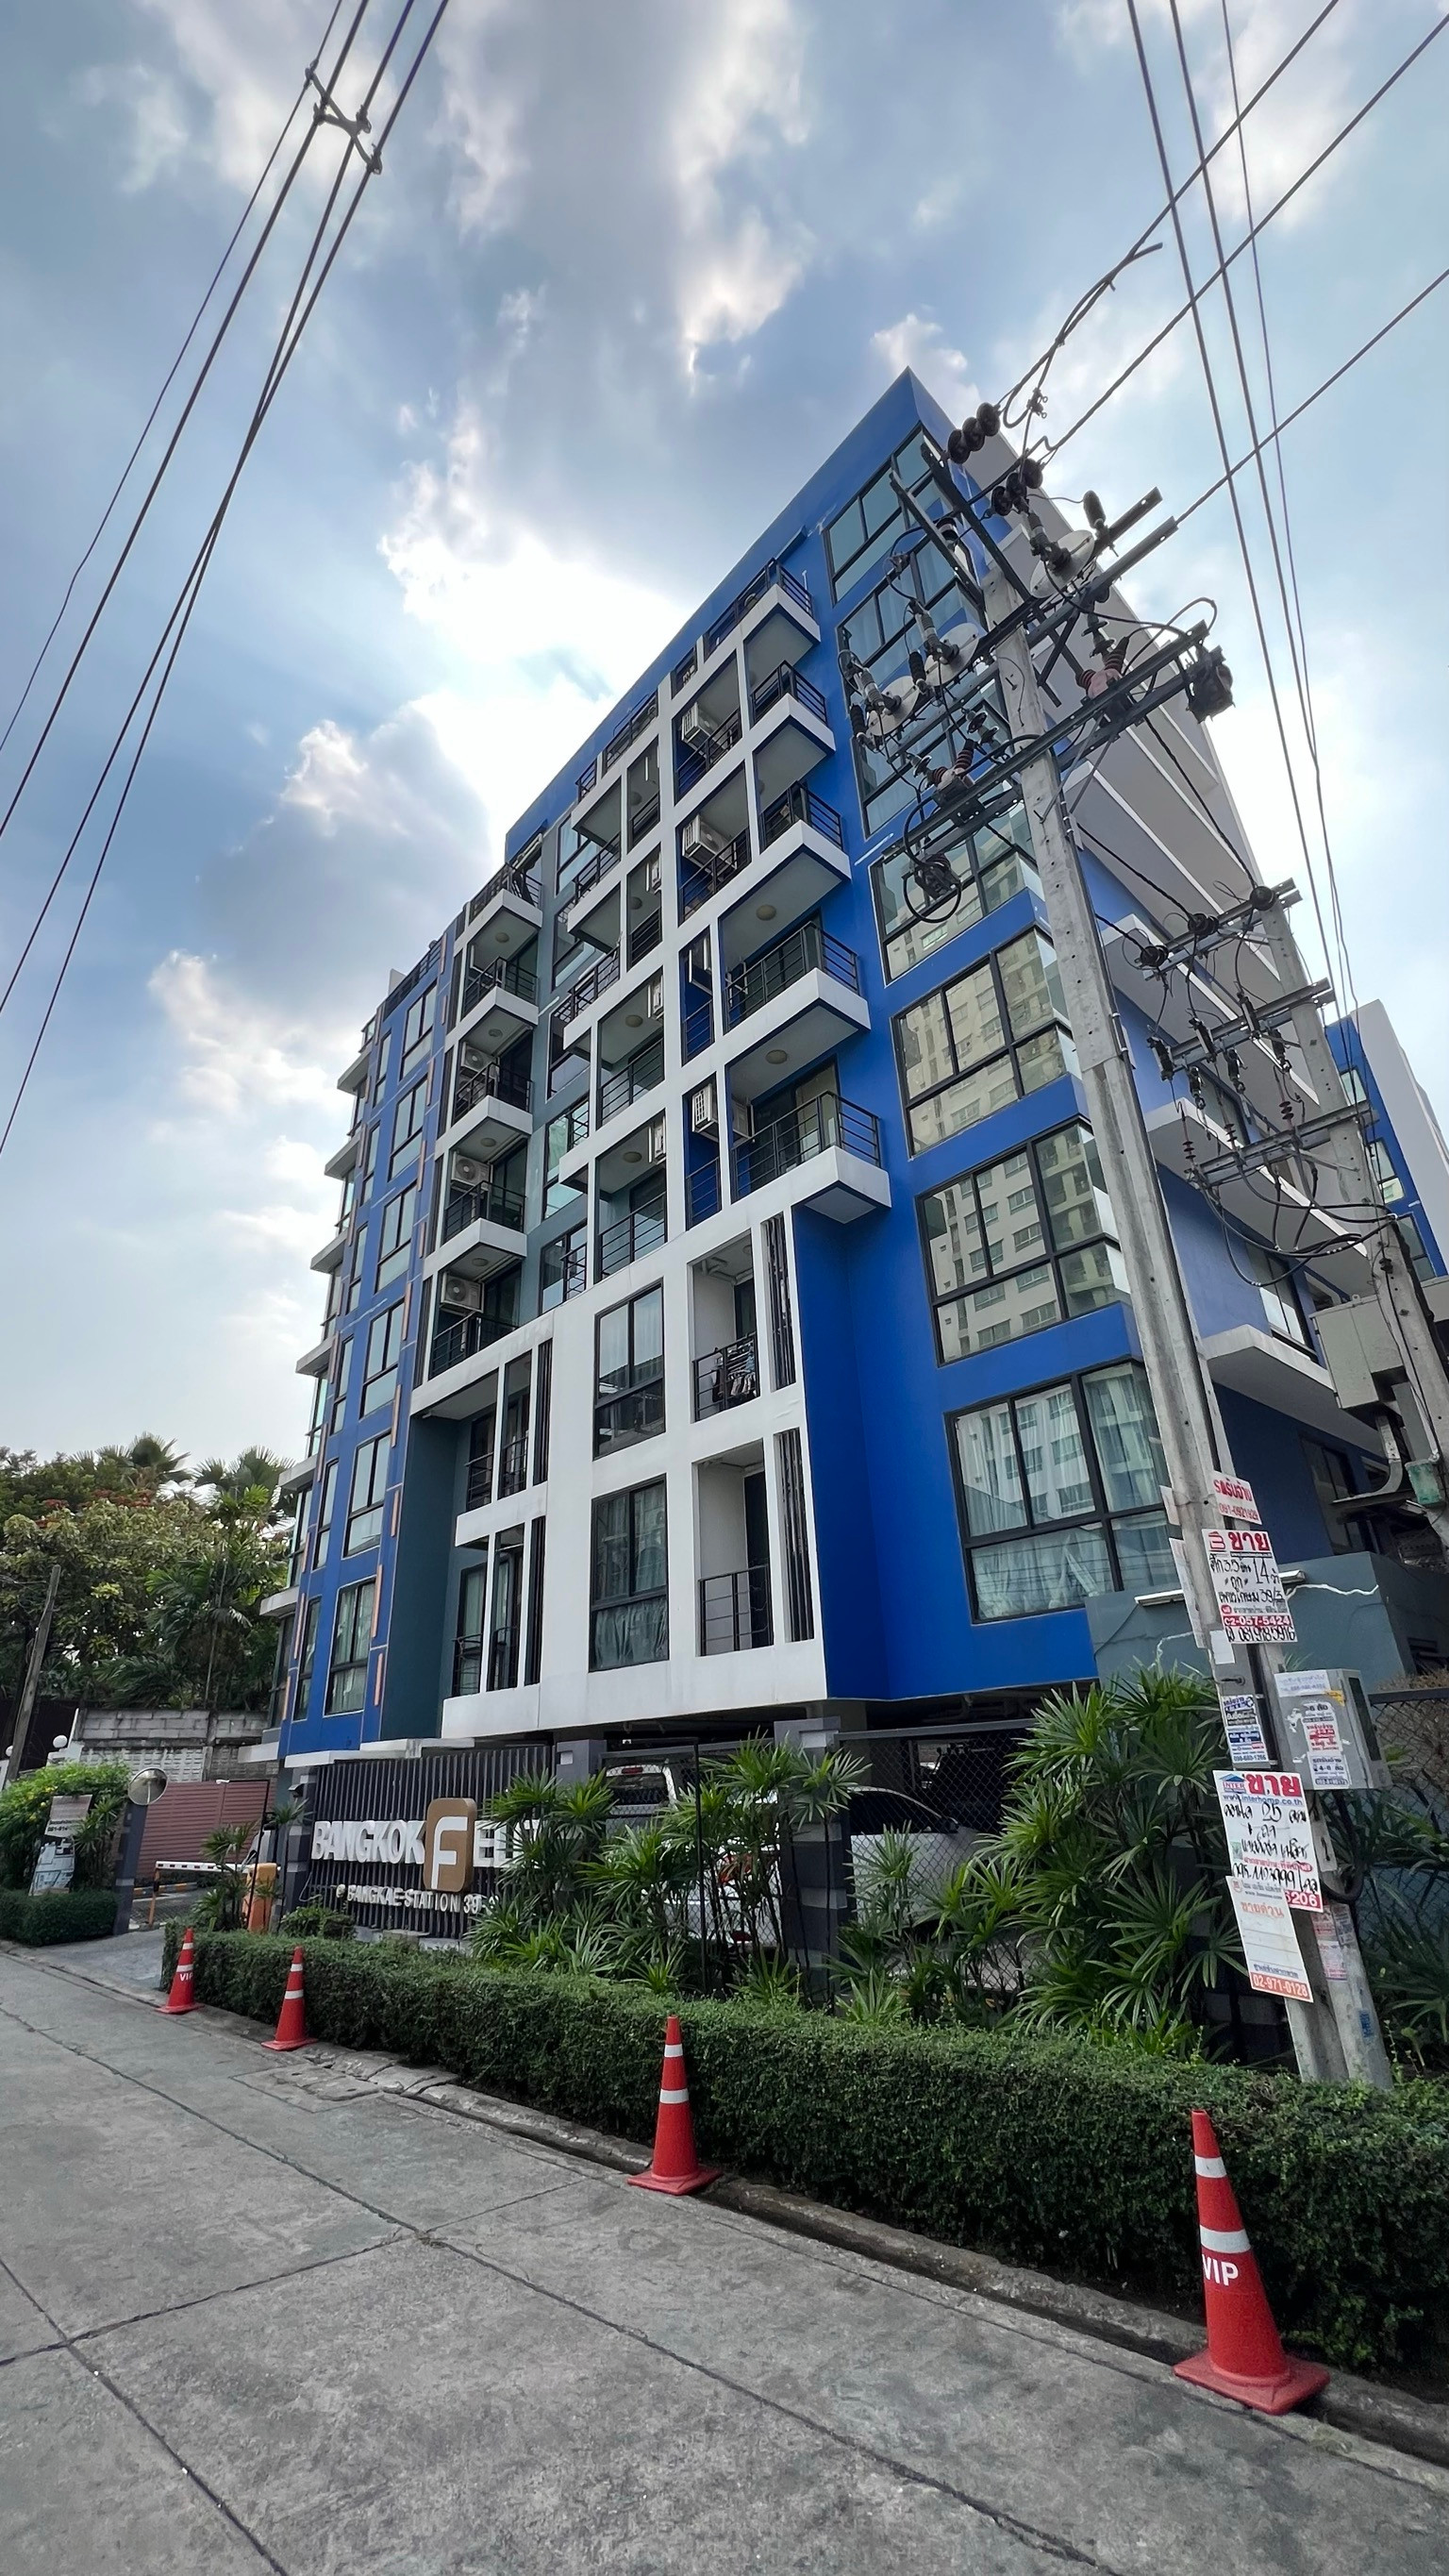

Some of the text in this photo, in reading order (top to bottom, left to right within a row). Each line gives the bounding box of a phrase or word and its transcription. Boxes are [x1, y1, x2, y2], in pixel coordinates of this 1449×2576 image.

[1227, 1531, 1271, 1550] ขาย
[1246, 1774, 1302, 1798] ขาย
[310, 1820, 426, 1865] BANGKOK
[1253, 1974, 1308, 1998] 02-971-0128
[1202, 2253, 1239, 2286] VIP
